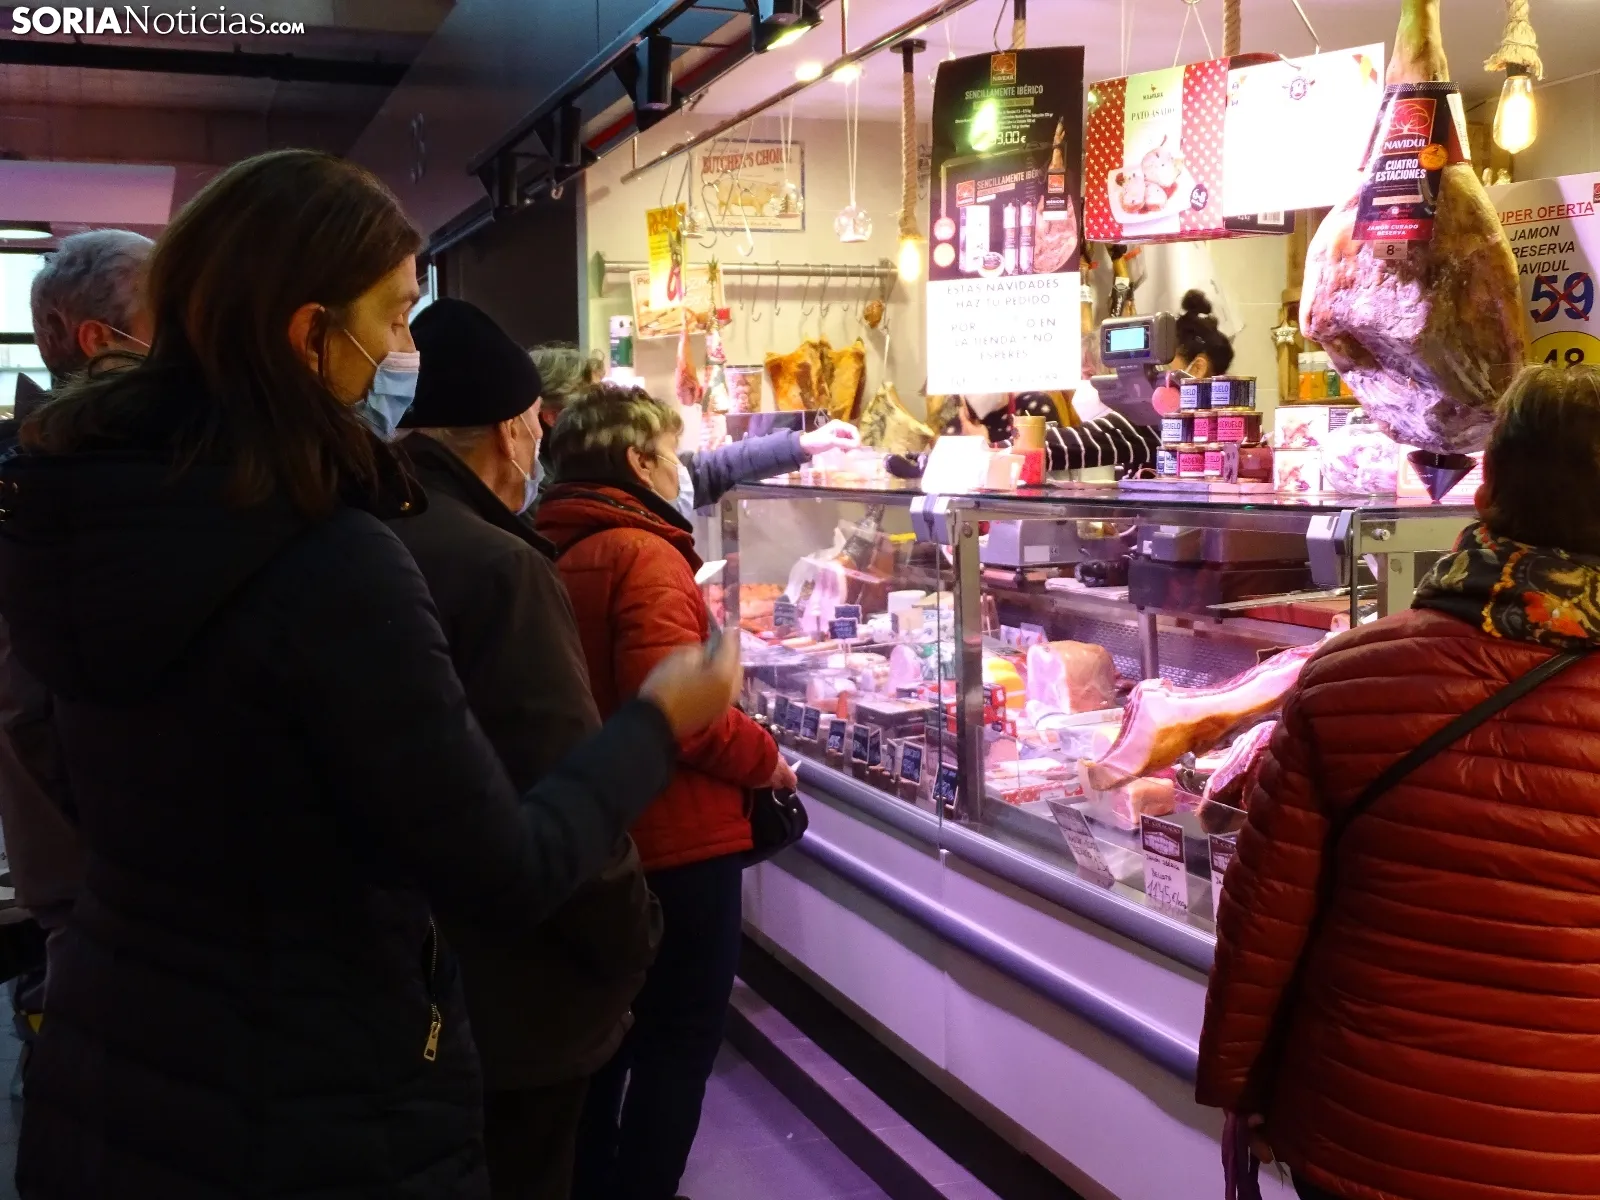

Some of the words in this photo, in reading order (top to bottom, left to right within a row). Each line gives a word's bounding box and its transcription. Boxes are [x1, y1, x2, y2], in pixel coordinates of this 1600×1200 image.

[1017, 84, 1044, 95] IBÉRICO
[1131, 111, 1149, 121] PATO
[1384, 138, 1425, 150] NAVIDUL
[1385, 159, 1418, 171] CUATRO
[977, 172, 1025, 190] SENCILLAMENTE
[1375, 169, 1427, 182] ESTACIONES
[1496, 209, 1533, 224] UPER
[1537, 201, 1594, 219] OFERTA
[1510, 225, 1560, 242] JAMON
[1386, 244, 1395, 255] 8
[1511, 241, 1575, 258] RESERVA
[1516, 260, 1570, 276] AVIDUL
[947, 284, 982, 295] ESTAS
[986, 278, 1059, 292] NAVIDADES
[956, 298, 981, 309] HAZ
[1005, 294, 1051, 306] PEDIDO
[1530, 271, 1594, 323] 59
[951, 321, 977, 332] POR
[1040, 317, 1056, 328] EN
[1033, 332, 1053, 343] NO
